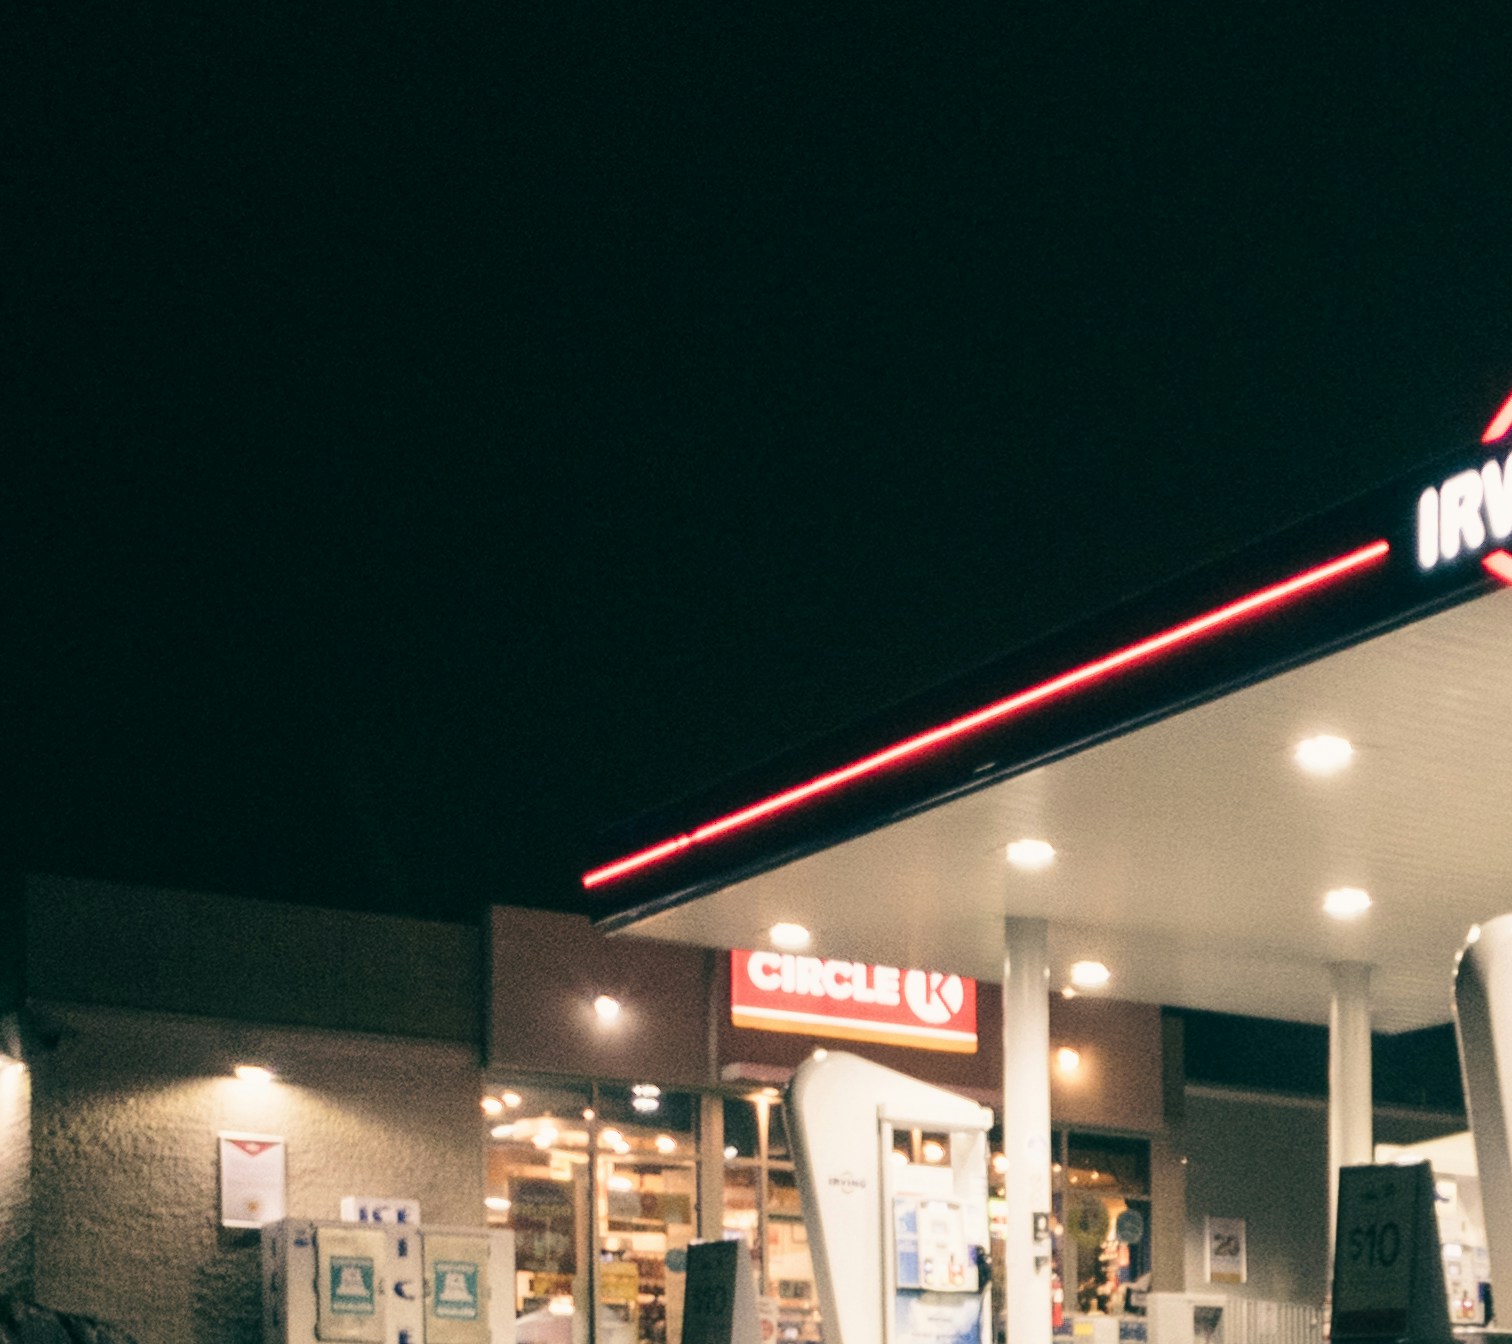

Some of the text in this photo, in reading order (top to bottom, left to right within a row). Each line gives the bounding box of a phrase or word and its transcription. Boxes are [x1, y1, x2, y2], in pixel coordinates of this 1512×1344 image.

[747, 950, 964, 1024] CIRCLE K
[1352, 1221, 1399, 1267] $10
